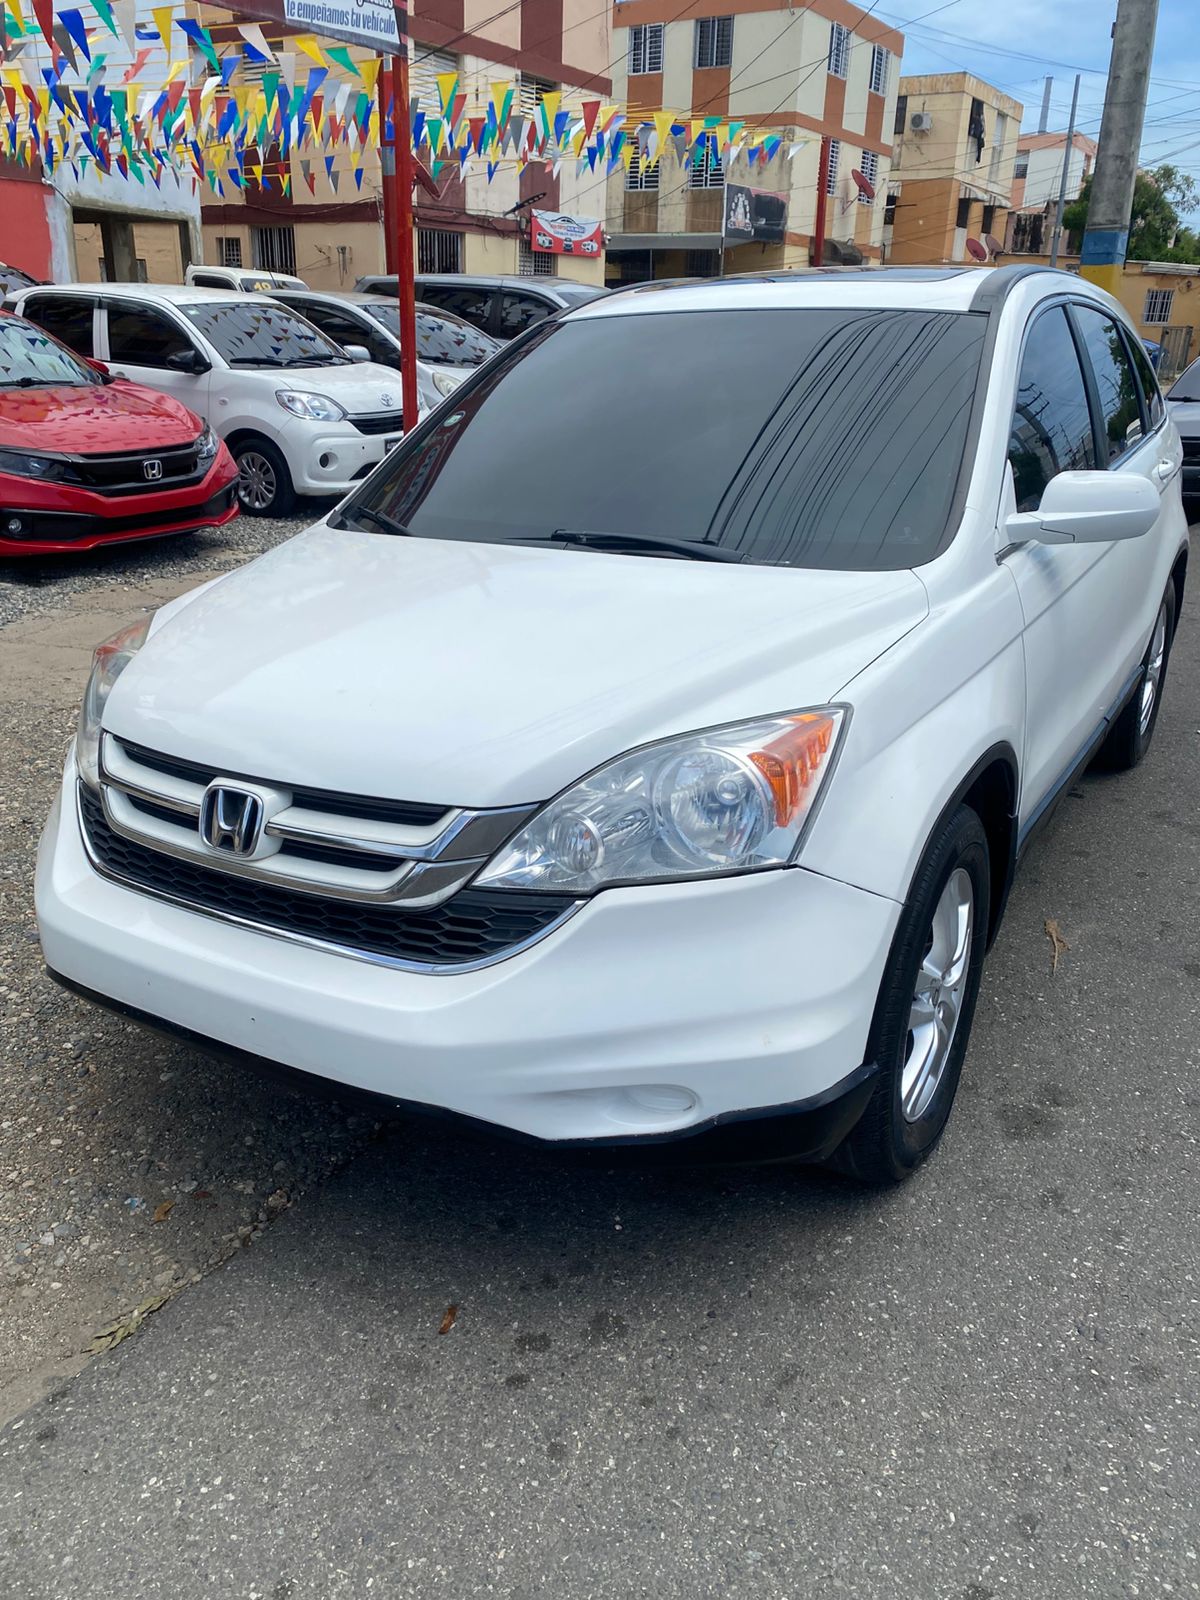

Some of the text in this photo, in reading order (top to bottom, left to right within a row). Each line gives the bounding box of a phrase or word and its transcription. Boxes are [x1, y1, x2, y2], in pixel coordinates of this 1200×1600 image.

[297, 2, 350, 26] empeñamos
[350, 8, 361, 28] tu
[362, 10, 395, 35] vehículo
